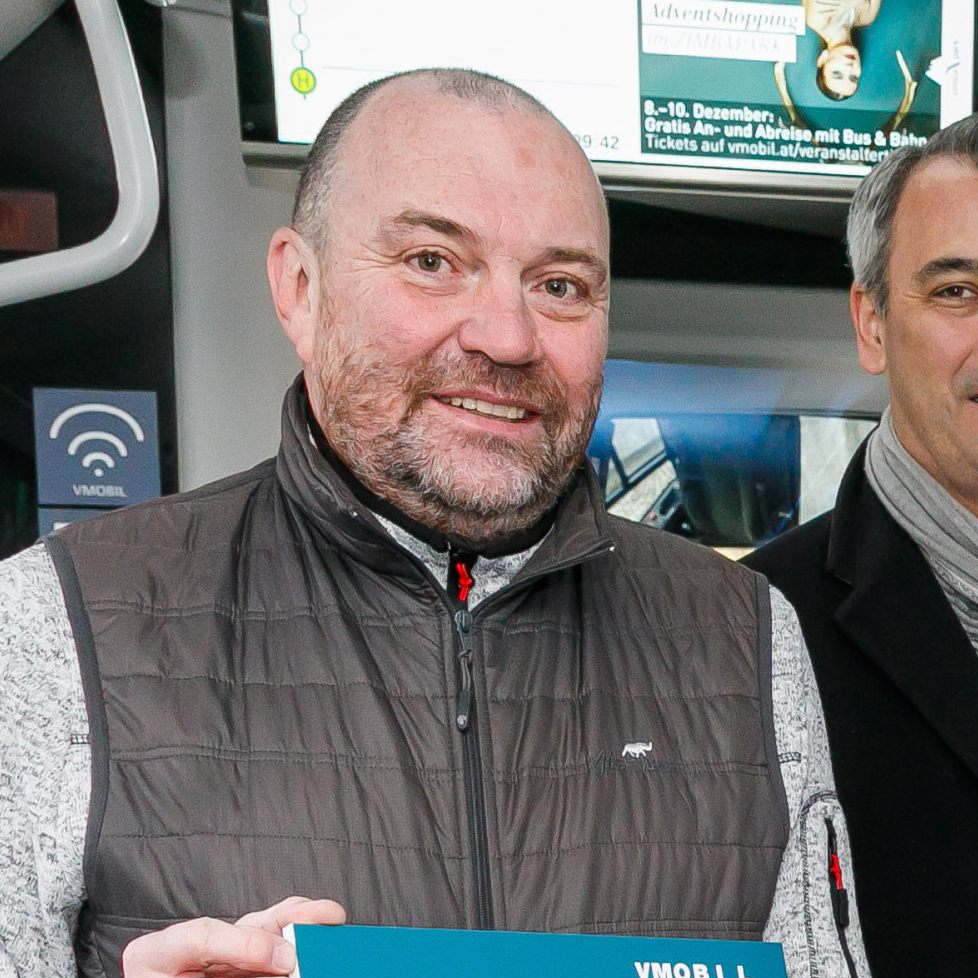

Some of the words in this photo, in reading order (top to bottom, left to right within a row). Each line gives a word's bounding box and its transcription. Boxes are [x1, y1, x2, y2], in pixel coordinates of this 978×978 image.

[650, 3, 798, 31] Adventshopping
[693, 102, 774, 123] Dezember:
[645, 117, 691, 134] Gratis
[693, 120, 721, 136] An-
[724, 123, 753, 138] und
[755, 124, 812, 142] Abreise
[815, 128, 840, 143] mit
[842, 128, 871, 145] Bus
[874, 130, 887, 146] &
[645, 134, 698, 152] Tickets
[701, 138, 725, 153] auf
